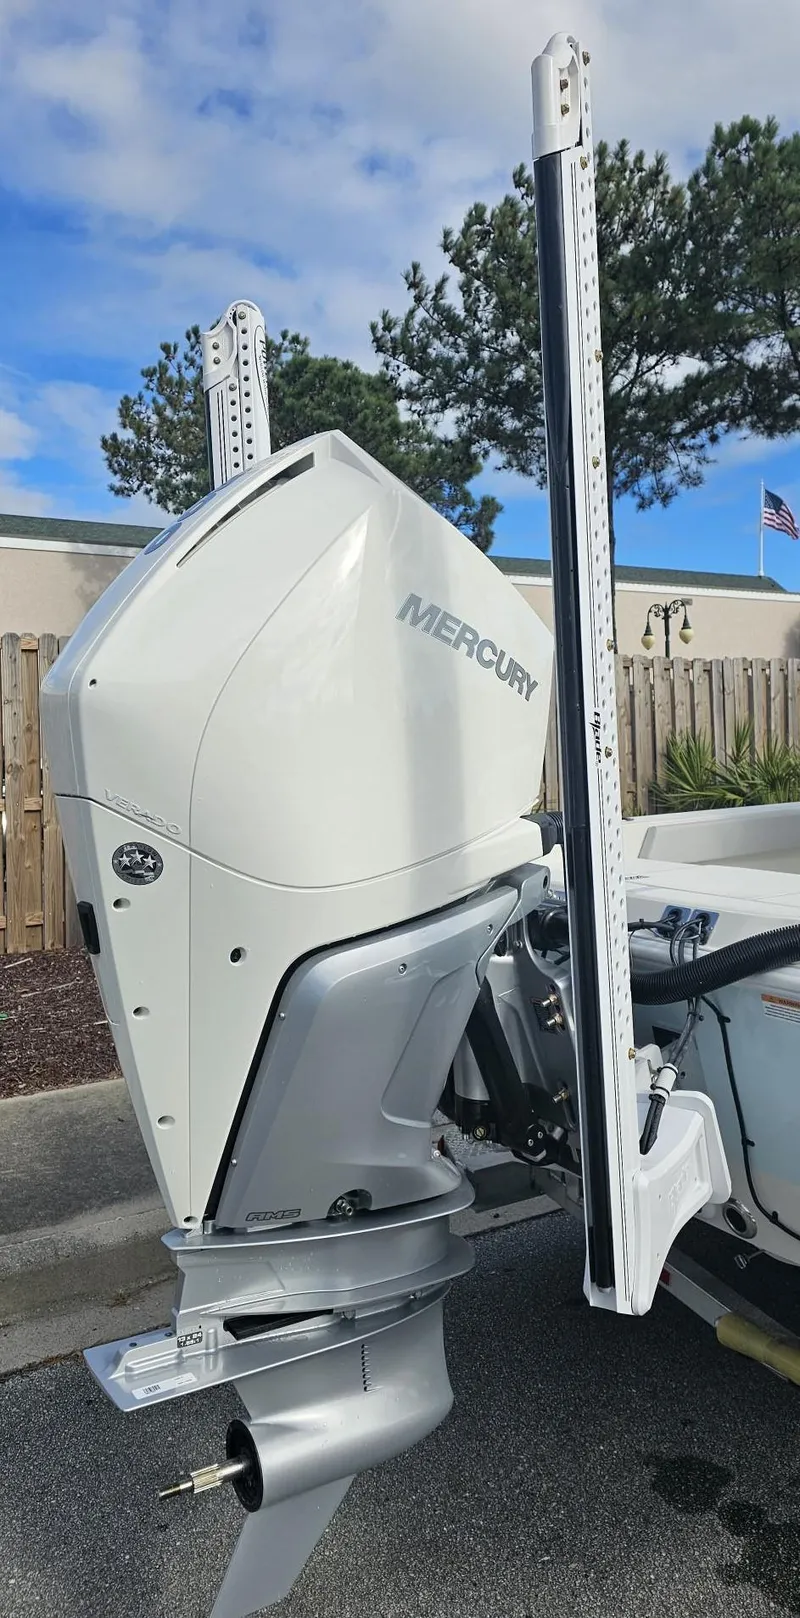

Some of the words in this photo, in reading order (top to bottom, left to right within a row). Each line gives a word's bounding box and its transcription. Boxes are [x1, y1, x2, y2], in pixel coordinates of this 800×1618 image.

[394, 592, 539, 702] MERCURY
[589, 711, 602, 764] Blade
[104, 788, 182, 835] VERADO
[245, 1208, 302, 1222] AMS
